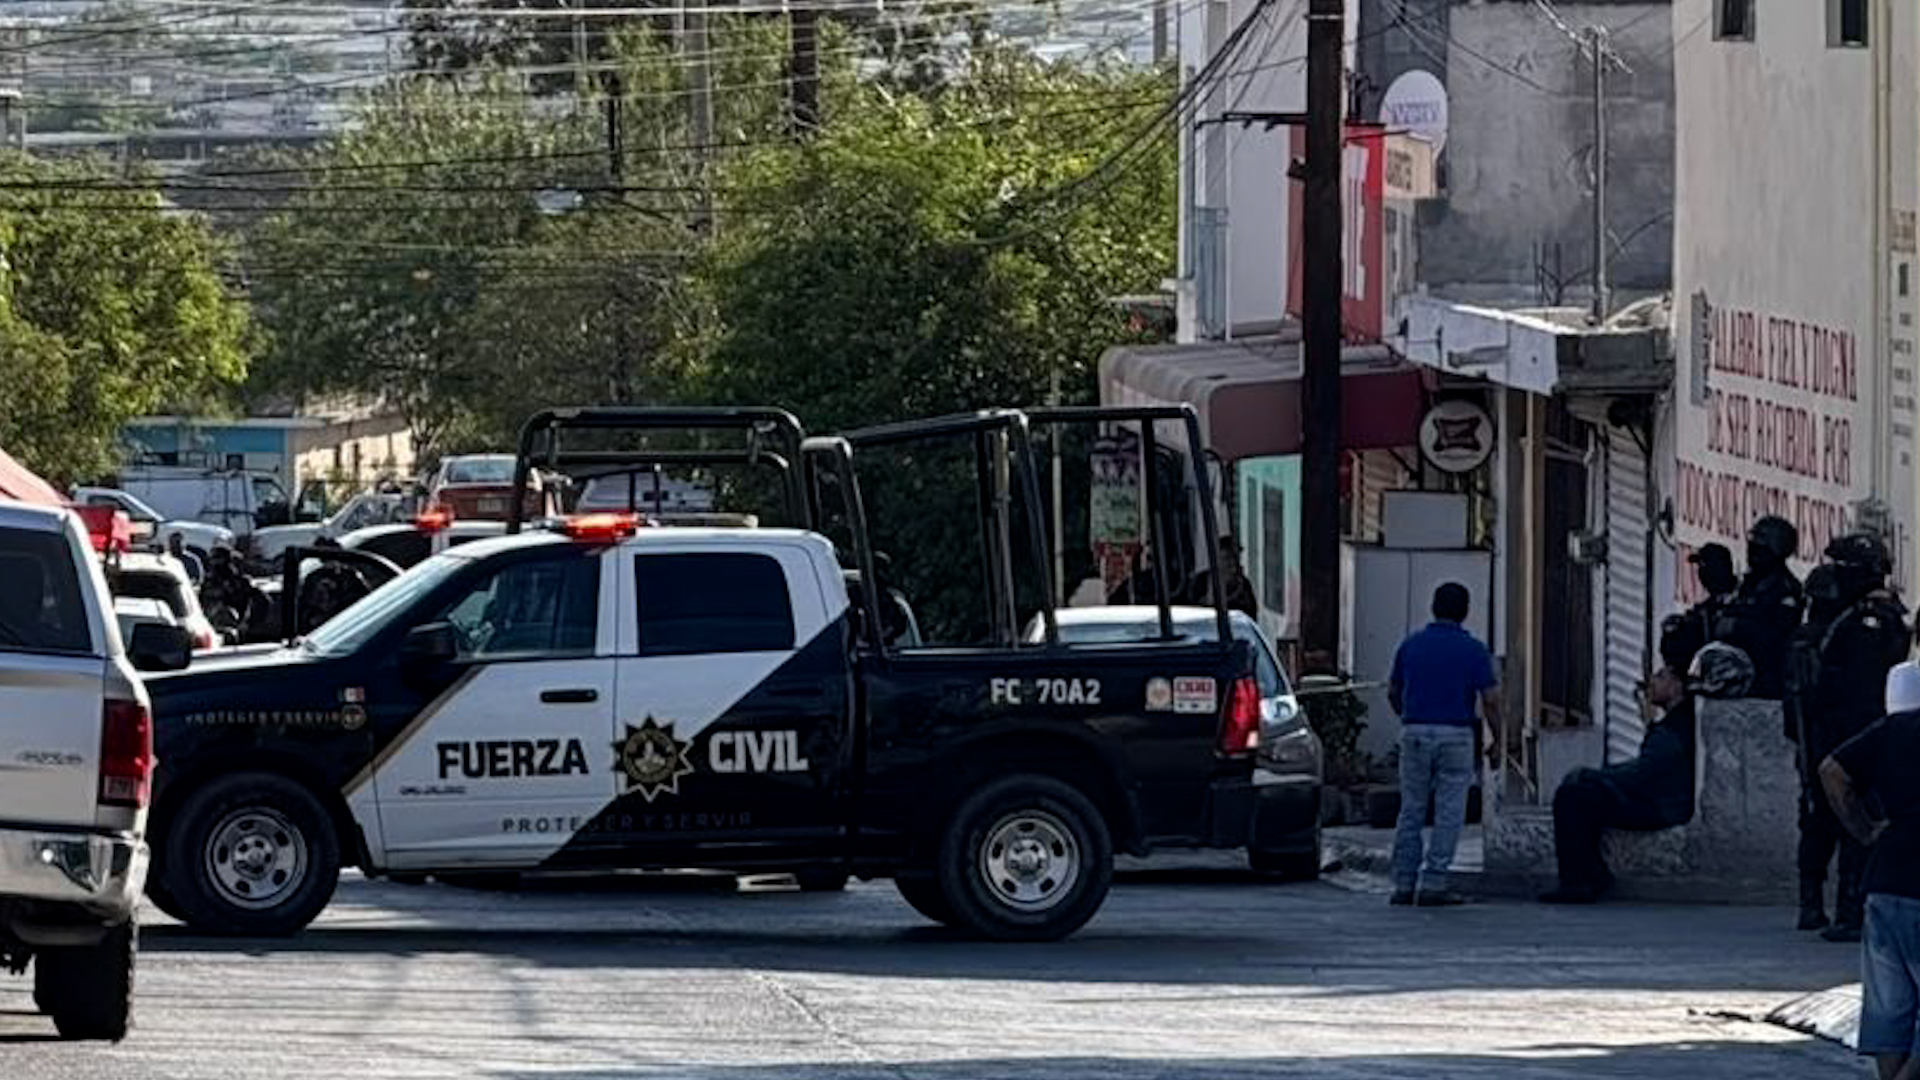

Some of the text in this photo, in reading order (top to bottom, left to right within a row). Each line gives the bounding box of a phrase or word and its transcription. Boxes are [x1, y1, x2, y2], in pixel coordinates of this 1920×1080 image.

[1768, 315, 1799, 389] FIEL
[1812, 323, 1857, 402] DIGNA
[1754, 397, 1818, 479] RECIBIDA
[1822, 413, 1851, 489] POR
[989, 677, 1022, 705] FC
[437, 729, 808, 779] FUERZA CIVIL
